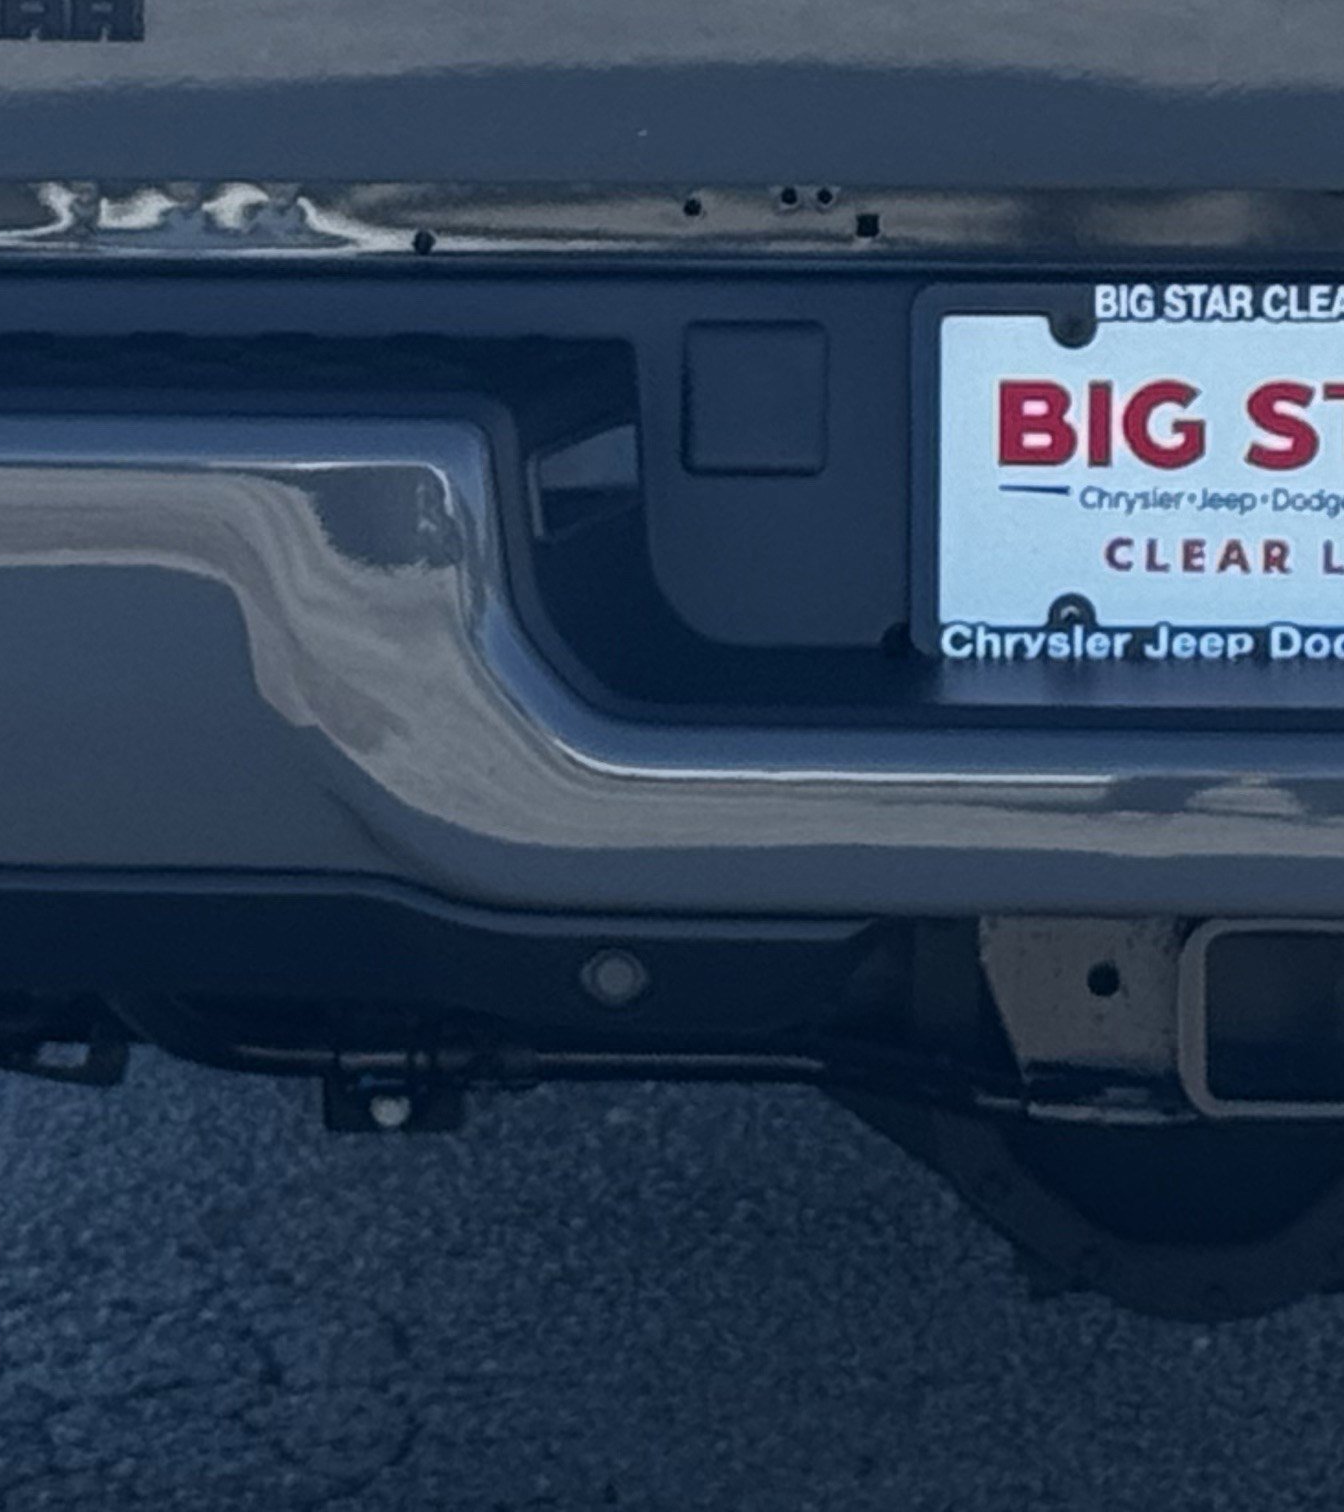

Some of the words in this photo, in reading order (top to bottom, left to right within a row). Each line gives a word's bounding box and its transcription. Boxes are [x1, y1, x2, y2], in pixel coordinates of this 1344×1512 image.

[1093, 284, 1155, 319] BIG
[1163, 284, 1254, 319] STAR
[997, 378, 1207, 471] BIG
[1078, 485, 1183, 515] Chrysler
[1196, 486, 1257, 515] Jeep
[1104, 536, 1291, 575] CLEAR
[940, 624, 1133, 660] Chrysler
[1143, 625, 1256, 661] Jeep
